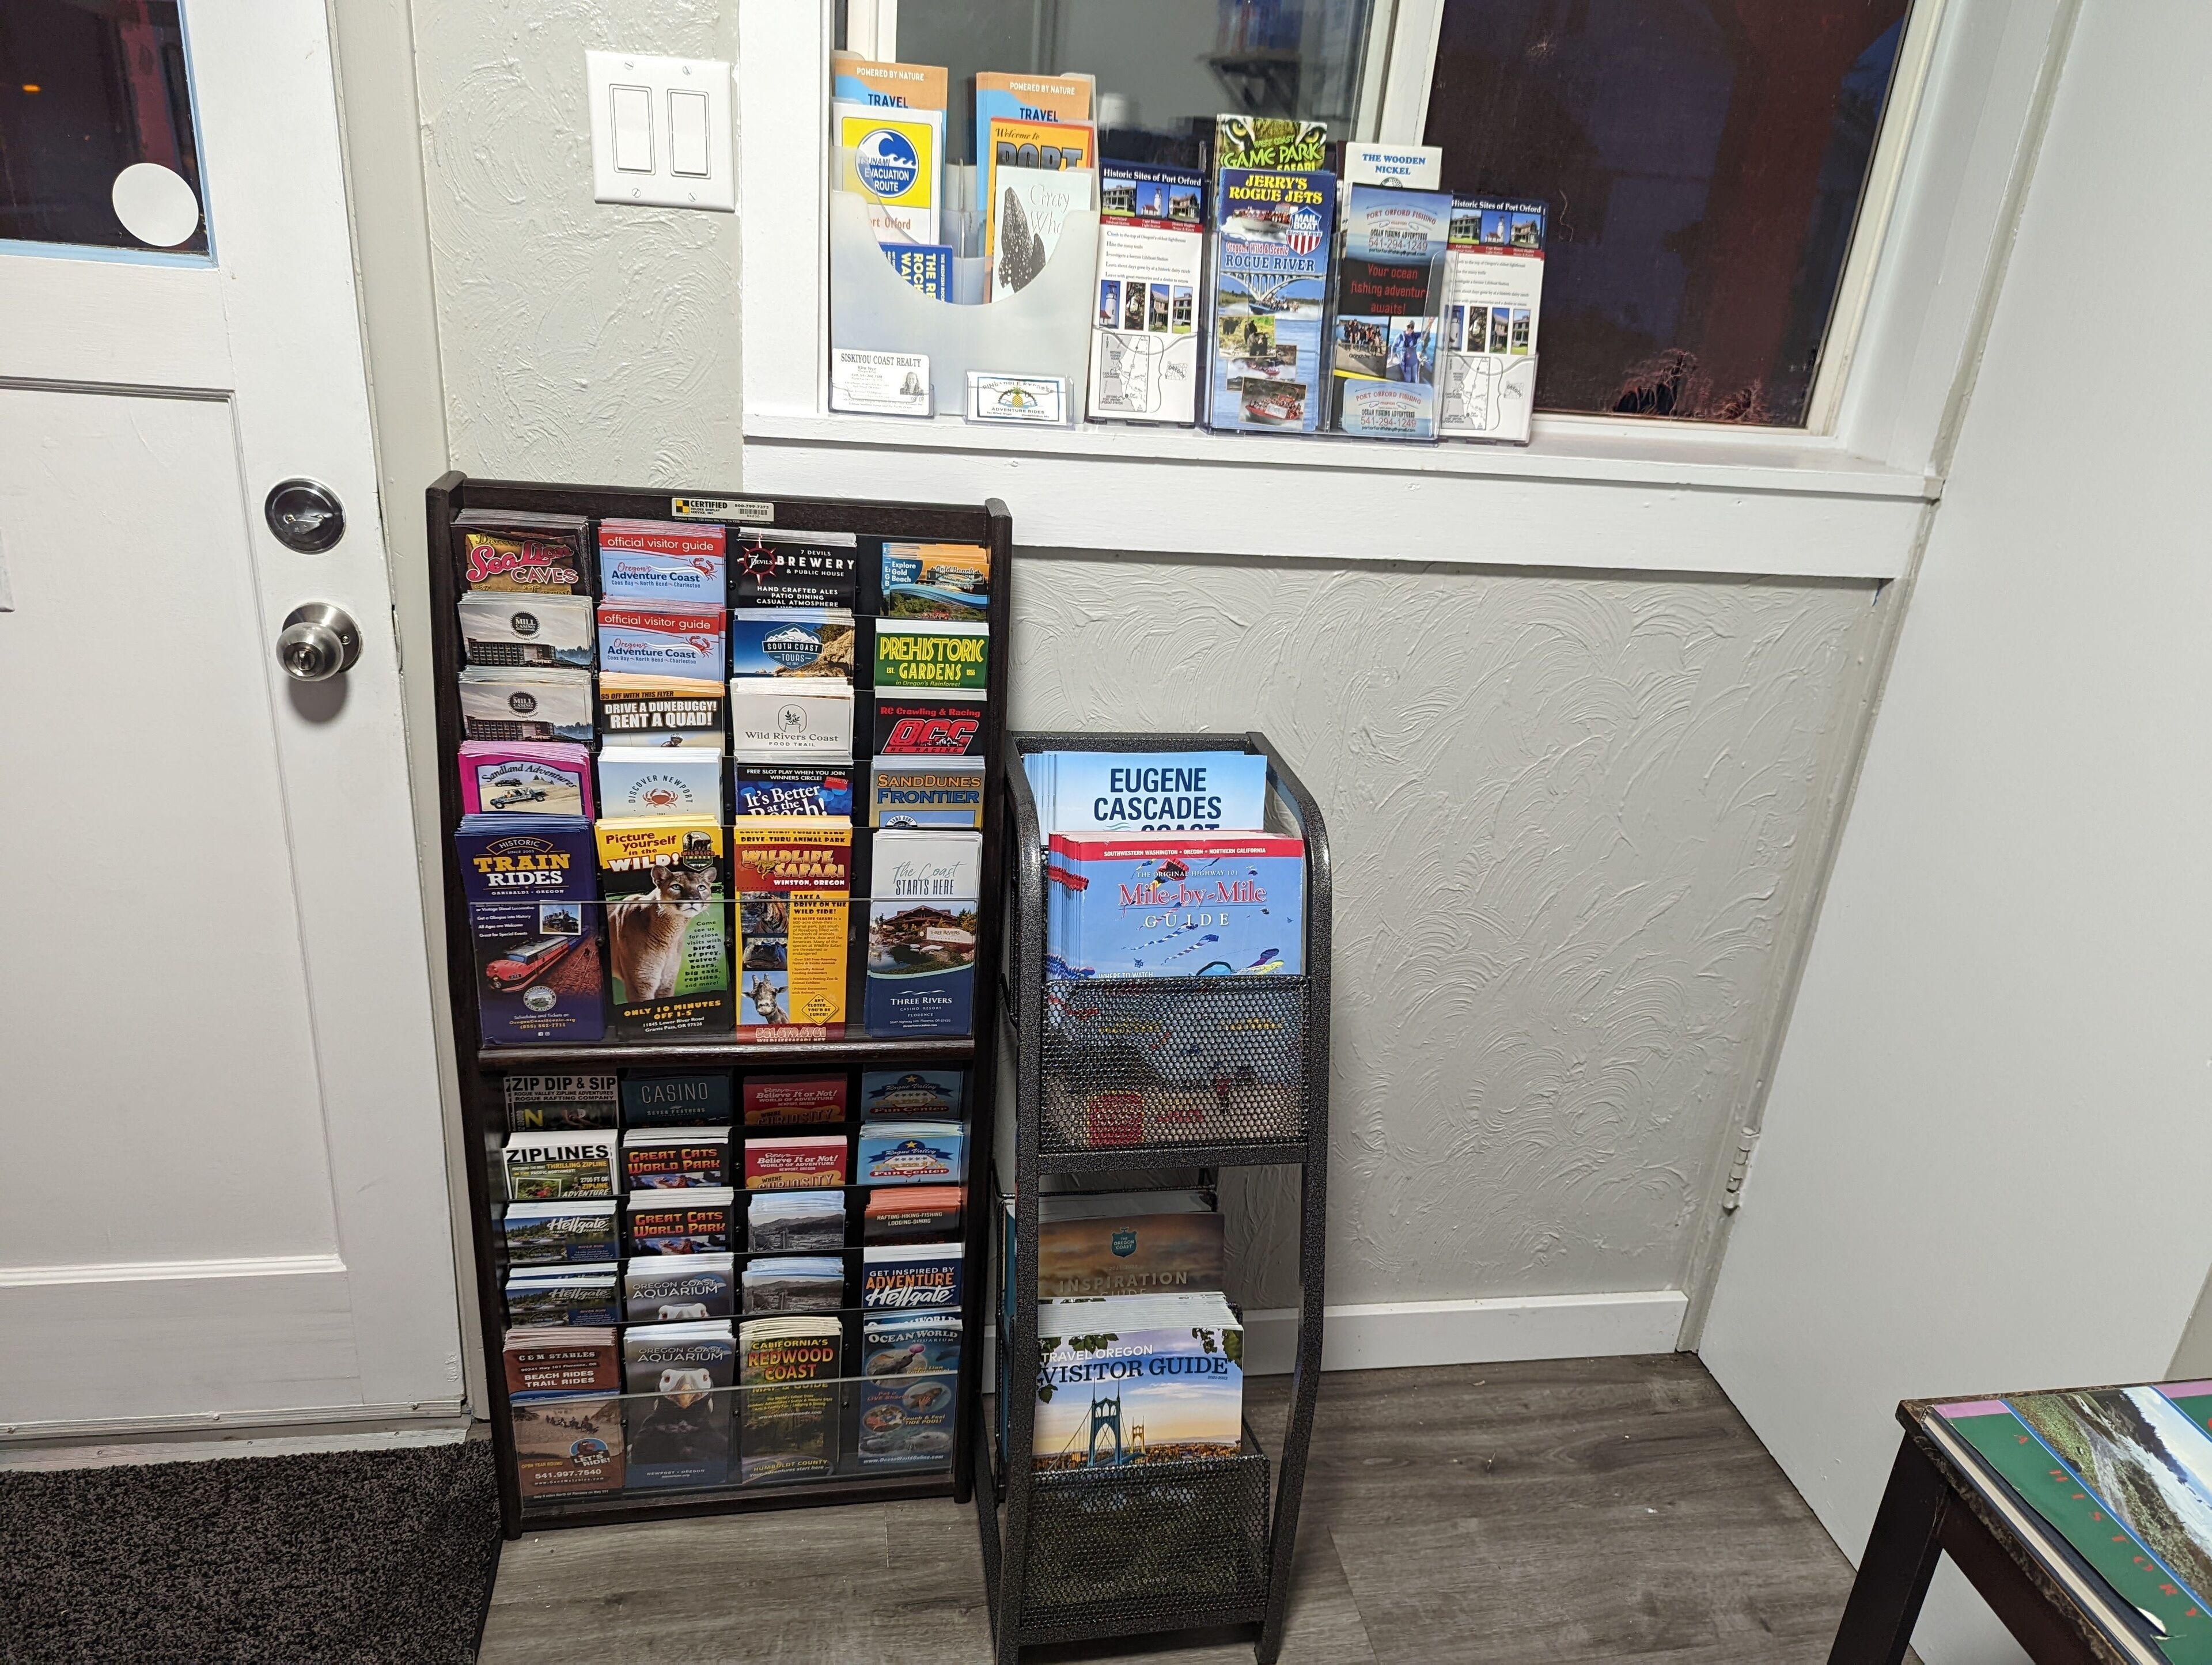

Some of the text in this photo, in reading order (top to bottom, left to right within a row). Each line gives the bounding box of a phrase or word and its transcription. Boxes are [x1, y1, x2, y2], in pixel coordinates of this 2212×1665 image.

[857, 68, 924, 81] POWERED BY NATURE
[868, 94, 908, 109] TRAVEL
[1220, 143, 1323, 168] GAME PARK
[1362, 154, 1426, 165] THE WOODEN
[865, 168, 909, 181] EVACUATION
[1104, 169, 1201, 186] Historic Sites of Port Orford
[1375, 166, 1411, 175] NICKEL
[874, 181, 899, 192] ROUTE
[1245, 175, 1308, 189] JERRY'S
[1229, 187, 1323, 204] ROGUE JETS
[1293, 221, 1317, 230] BOAT
[1295, 214, 1316, 223] MAIL
[1366, 211, 1382, 219] PORT
[1412, 212, 1436, 225] FISHING
[1368, 238, 1427, 251] 541-294-1249
[1226, 256, 1315, 272] ROGUE RIVER
[1368, 264, 1418, 280] Your ocean
[1351, 280, 1382, 298] fishing
[1370, 302, 1406, 315] awaits!
[841, 354, 922, 367] SISKIYOU COAST REALTY
[690, 500, 728, 509] CERTIFIED
[607, 537, 714, 553] official visitor guide
[467, 540, 574, 582] Sea Lion
[777, 556, 855, 570] BREWERY
[892, 561, 916, 570] Explore
[512, 567, 579, 584] CAVES
[611, 570, 700, 582] Adventure Coast
[767, 643, 819, 652] SOUTH COAST
[879, 636, 984, 663] PREHISTORIC
[781, 653, 805, 662] TOURS
[899, 663, 961, 680] GARDENS
[605, 700, 717, 714] DRIVE A DUNEBUGGY!
[881, 707, 894, 715] RC
[896, 707, 937, 716] Crawling
[948, 708, 980, 718] Racing
[610, 712, 713, 729] RENT A QUAD!
[745, 731, 839, 742] Wild Rivers Coast
[482, 764, 577, 788] Sandland Adventures
[877, 775, 981, 787] SANDDUNES
[1111, 768, 1207, 792] EUGENE
[628, 775, 693, 803] DISCOVER NEWPORT
[877, 788, 979, 804] FRONTIER
[745, 786, 820, 808] It's Better
[1094, 796, 1222, 821] CASCADES
[499, 840, 540, 848] HISTORIC
[605, 831, 655, 844] Picture
[622, 835, 676, 852] yourself
[473, 854, 570, 873] TRAIN
[608, 854, 679, 872] WILD!
[741, 849, 834, 865] WILDLIFE
[488, 870, 563, 886] RIDES
[773, 864, 845, 879] SAFARI
[1192, 869, 1225, 877] HIGHWAY
[896, 880, 954, 896] STARTS HERE
[1118, 880, 1267, 909] Mile-by-Mile
[1145, 913, 1230, 928] GUIDE
[510, 1076, 616, 1091] ZIP DIP & SIP
[641, 1082, 709, 1103] CASINO
[506, 1145, 608, 1163] ZIPLINES
[629, 1148, 718, 1162] GREAT CATS
[627, 1160, 721, 1174] WORLD PARK
[892, 1268, 938, 1276] INSPIRED
[632, 1279, 716, 1289] OREGON COAST
[866, 1272, 955, 1289] ADVENTURE
[1059, 1271, 1188, 1292] INSPIRATION
[632, 1285, 718, 1299] AQUARIUM
[865, 1285, 957, 1306] Hellgate
[752, 1338, 828, 1350] CALIFORNIA'S
[868, 1330, 958, 1344] OCEAN WORLD
[748, 1348, 834, 1366] REDWOOD
[1042, 1344, 1153, 1363] TRAVEL OREGON
[524, 1370, 594, 1381] BEACH RIDES
[764, 1364, 816, 1380] COAST
[1041, 1357, 1229, 1384] VISITOR GUIDE
[535, 1469, 602, 1479] 541.997.7540
